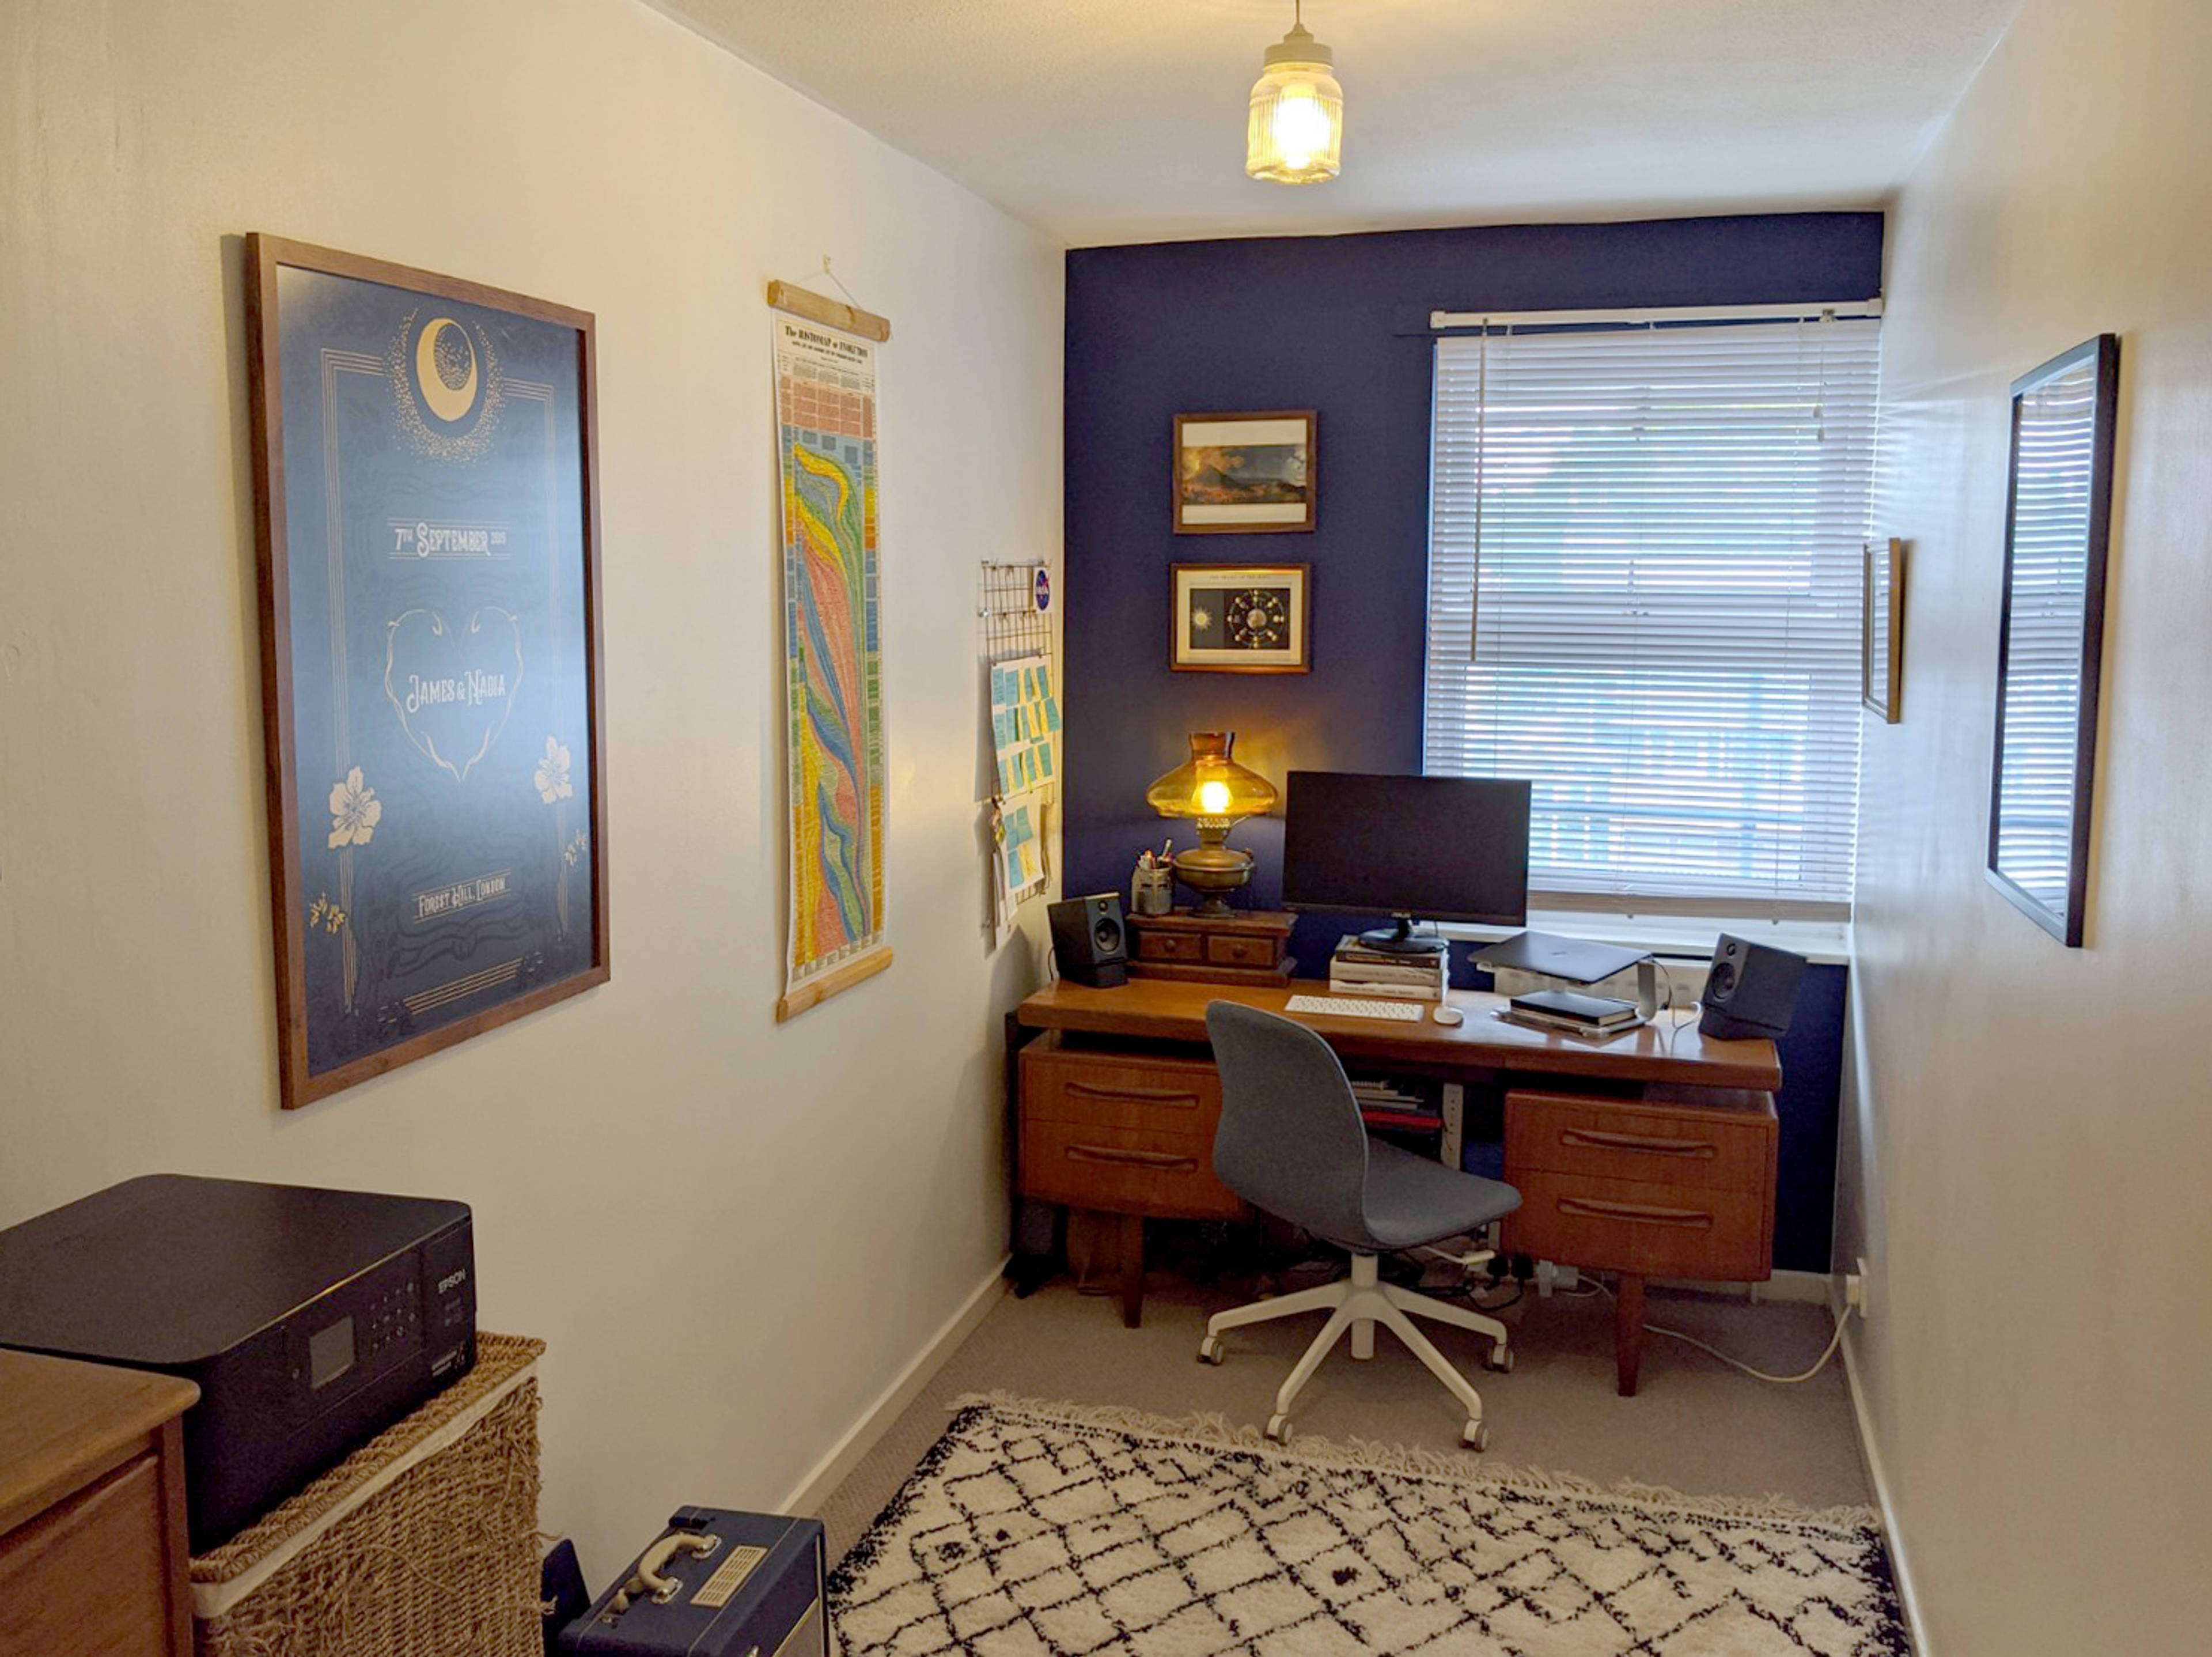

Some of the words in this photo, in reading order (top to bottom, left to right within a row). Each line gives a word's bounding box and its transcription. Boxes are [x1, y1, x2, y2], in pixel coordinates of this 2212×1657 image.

[416, 522, 492, 558] SEPTEMBER
[407, 675, 455, 713] JAMES
[457, 681, 465, 700] &
[464, 669, 506, 707] NADIA
[418, 893, 450, 918] FOREST
[438, 1269, 466, 1295] EPSON
